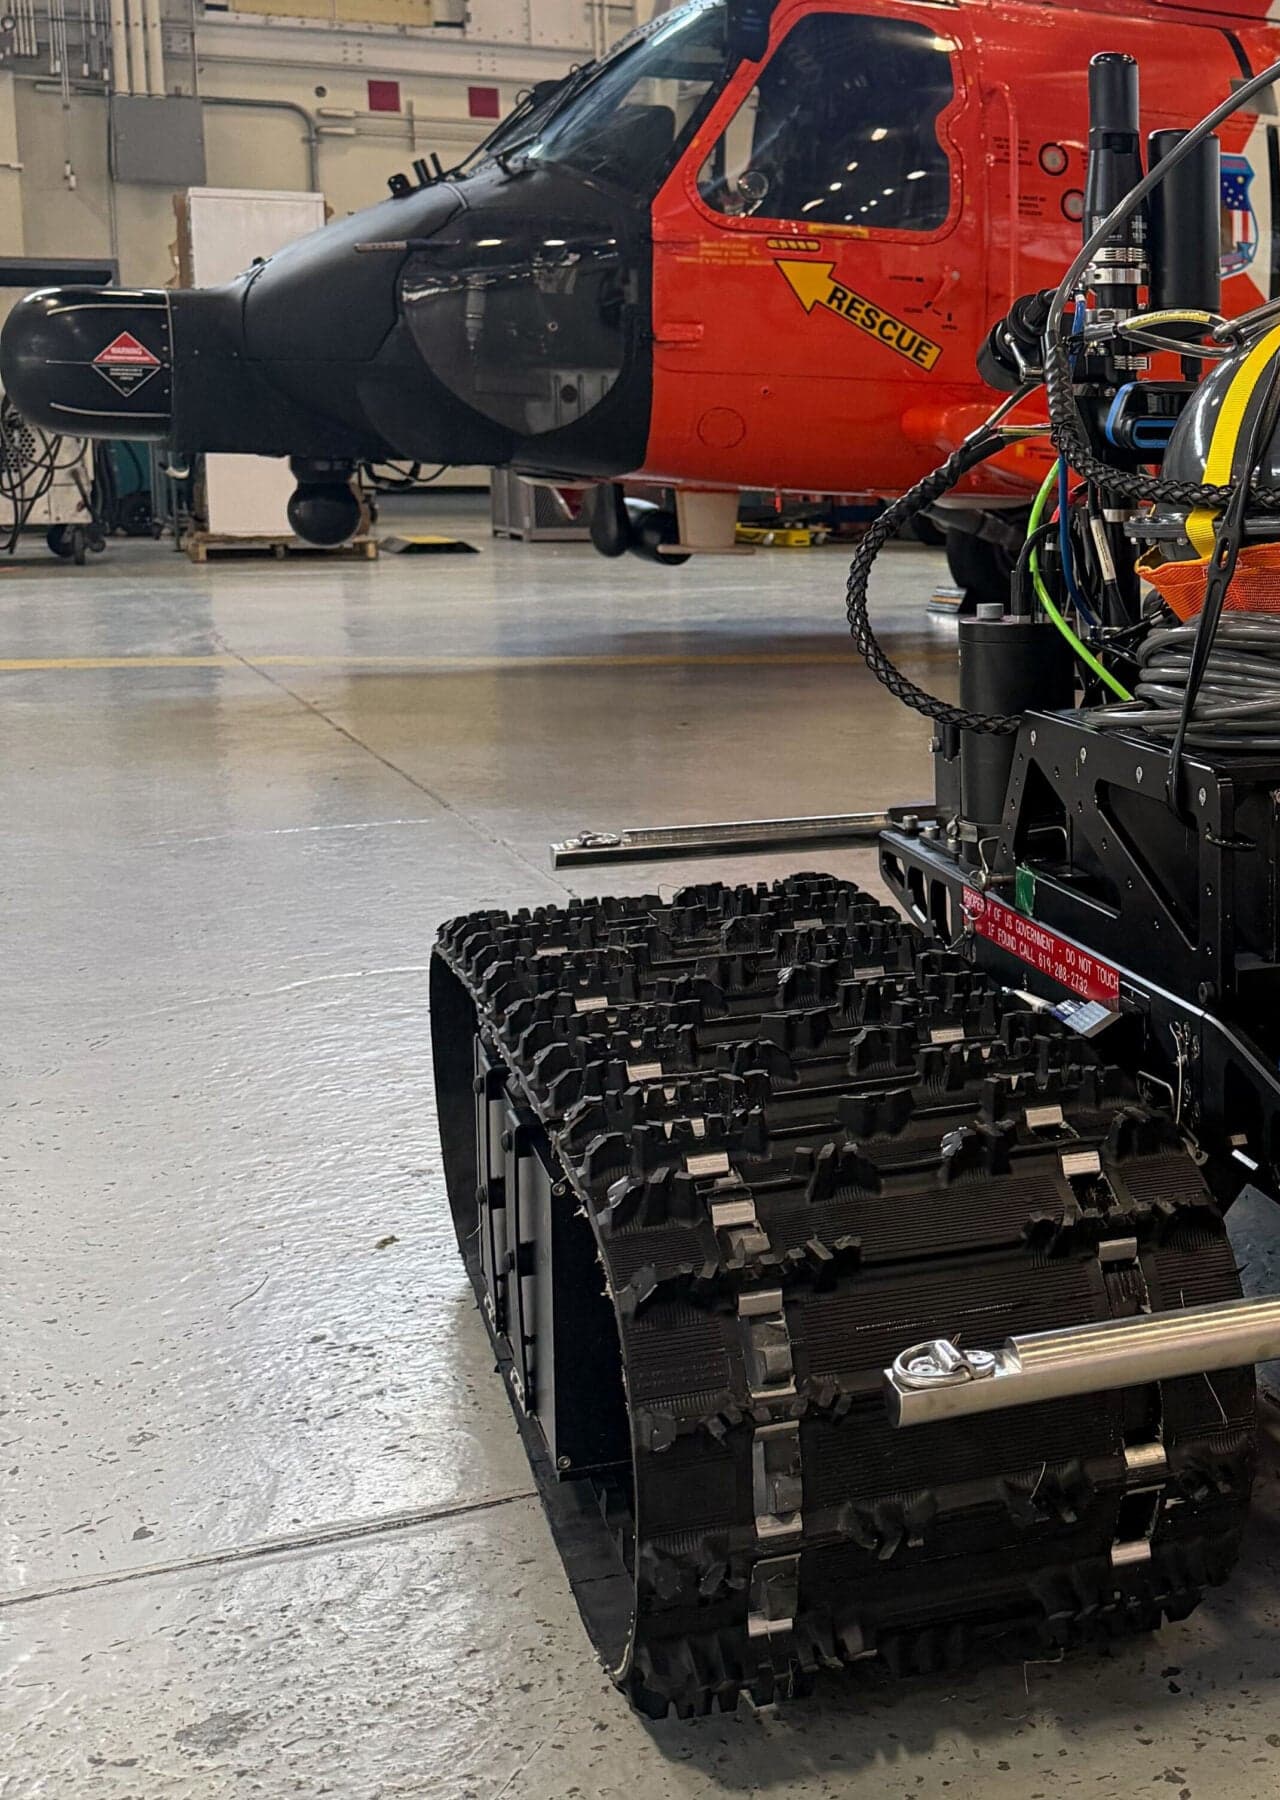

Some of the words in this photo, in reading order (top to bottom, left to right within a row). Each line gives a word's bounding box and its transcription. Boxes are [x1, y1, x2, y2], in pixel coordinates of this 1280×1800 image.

[826, 285, 934, 364] RESCUE
[963, 889, 991, 917] PROPERY
[994, 907, 1002, 921] OF
[1004, 912, 1012, 930] US
[1016, 919, 1054, 954] GOVERNMENT
[1066, 947, 1076, 966] DO
[1079, 955, 1092, 976] NOT
[1096, 964, 1119, 992] TOUCH
[988, 921, 995, 937] IF
[997, 927, 1017, 951] FOUND
[1020, 941, 1036, 963] CALL
